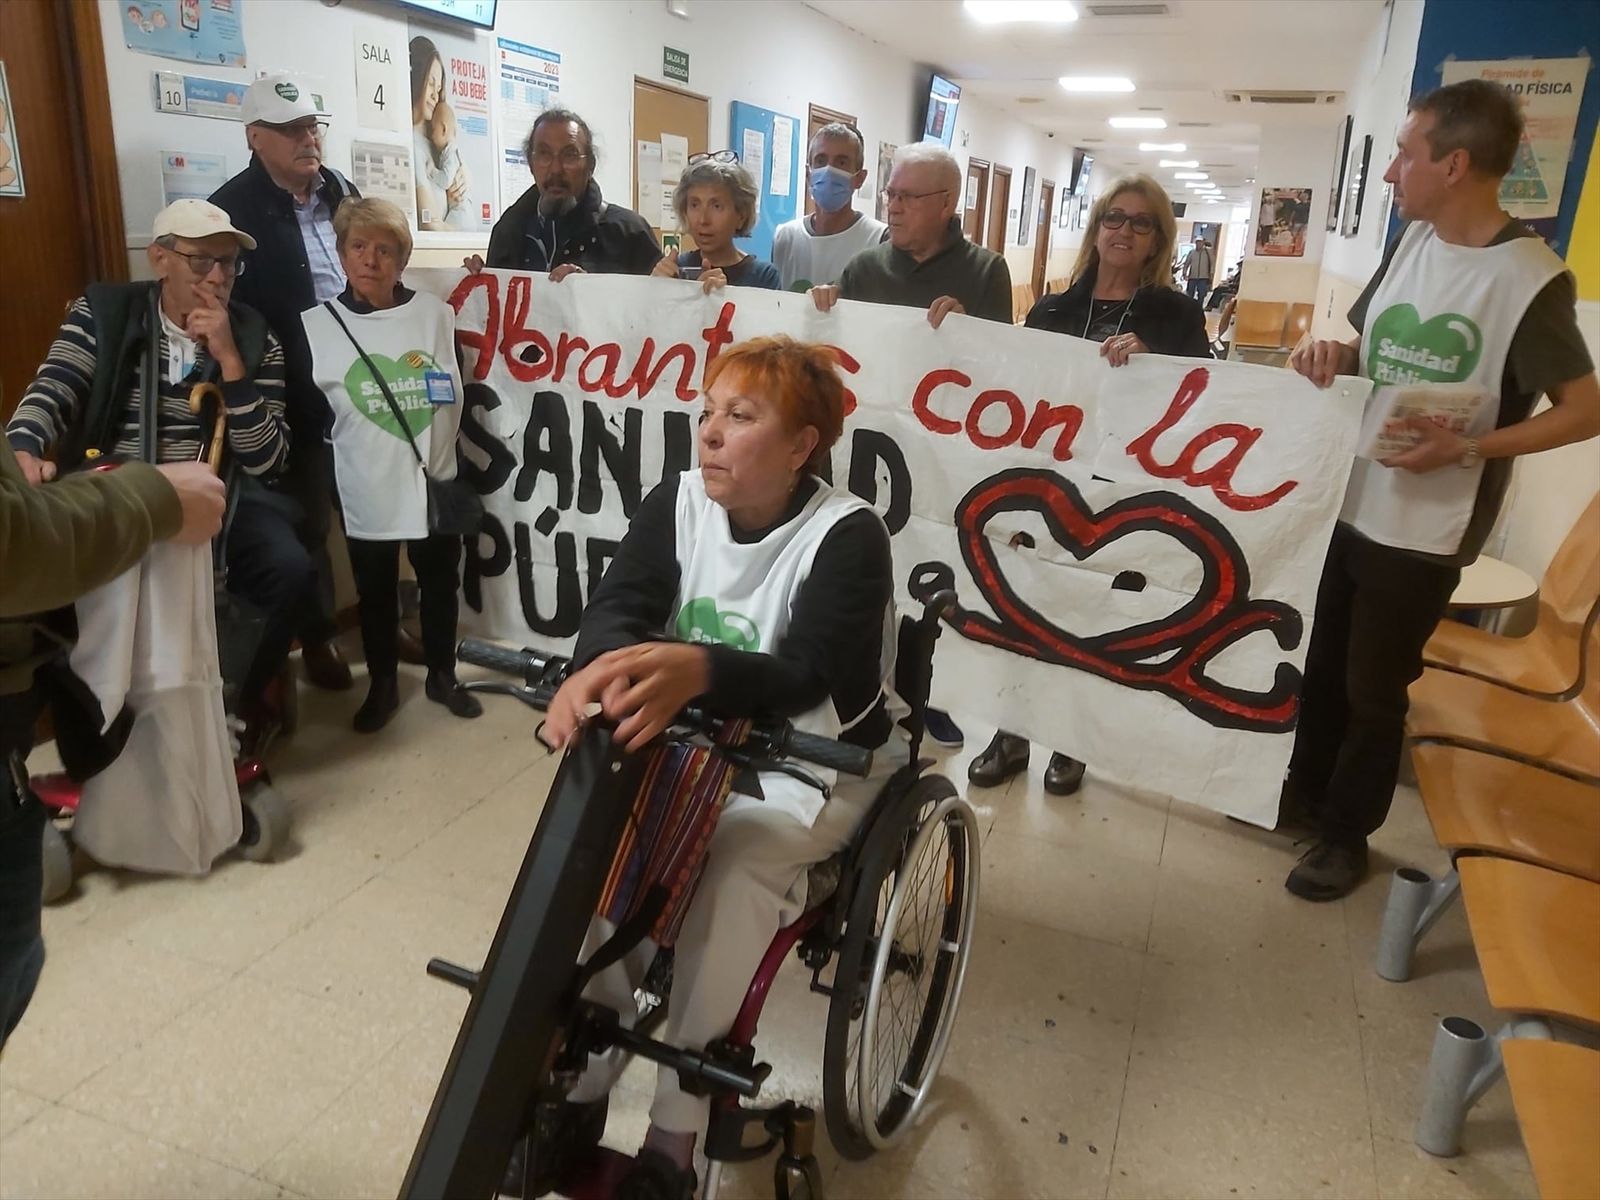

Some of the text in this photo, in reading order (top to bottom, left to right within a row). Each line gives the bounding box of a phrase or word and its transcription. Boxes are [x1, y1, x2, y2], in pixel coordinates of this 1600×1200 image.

[362, 43, 391, 64] SALA
[451, 58, 486, 81] PROTEJA
[166, 91, 182, 106] 10
[374, 84, 385, 111] 4
[452, 79, 457, 95] A
[459, 81, 468, 97] SU
[1526, 82, 1573, 95] FÍSICA
[1378, 337, 1460, 373] Sanidad
[361, 377, 427, 396] Sanida
[447, 273, 1298, 511] Abrant con la
[457, 383, 912, 535] SANID
